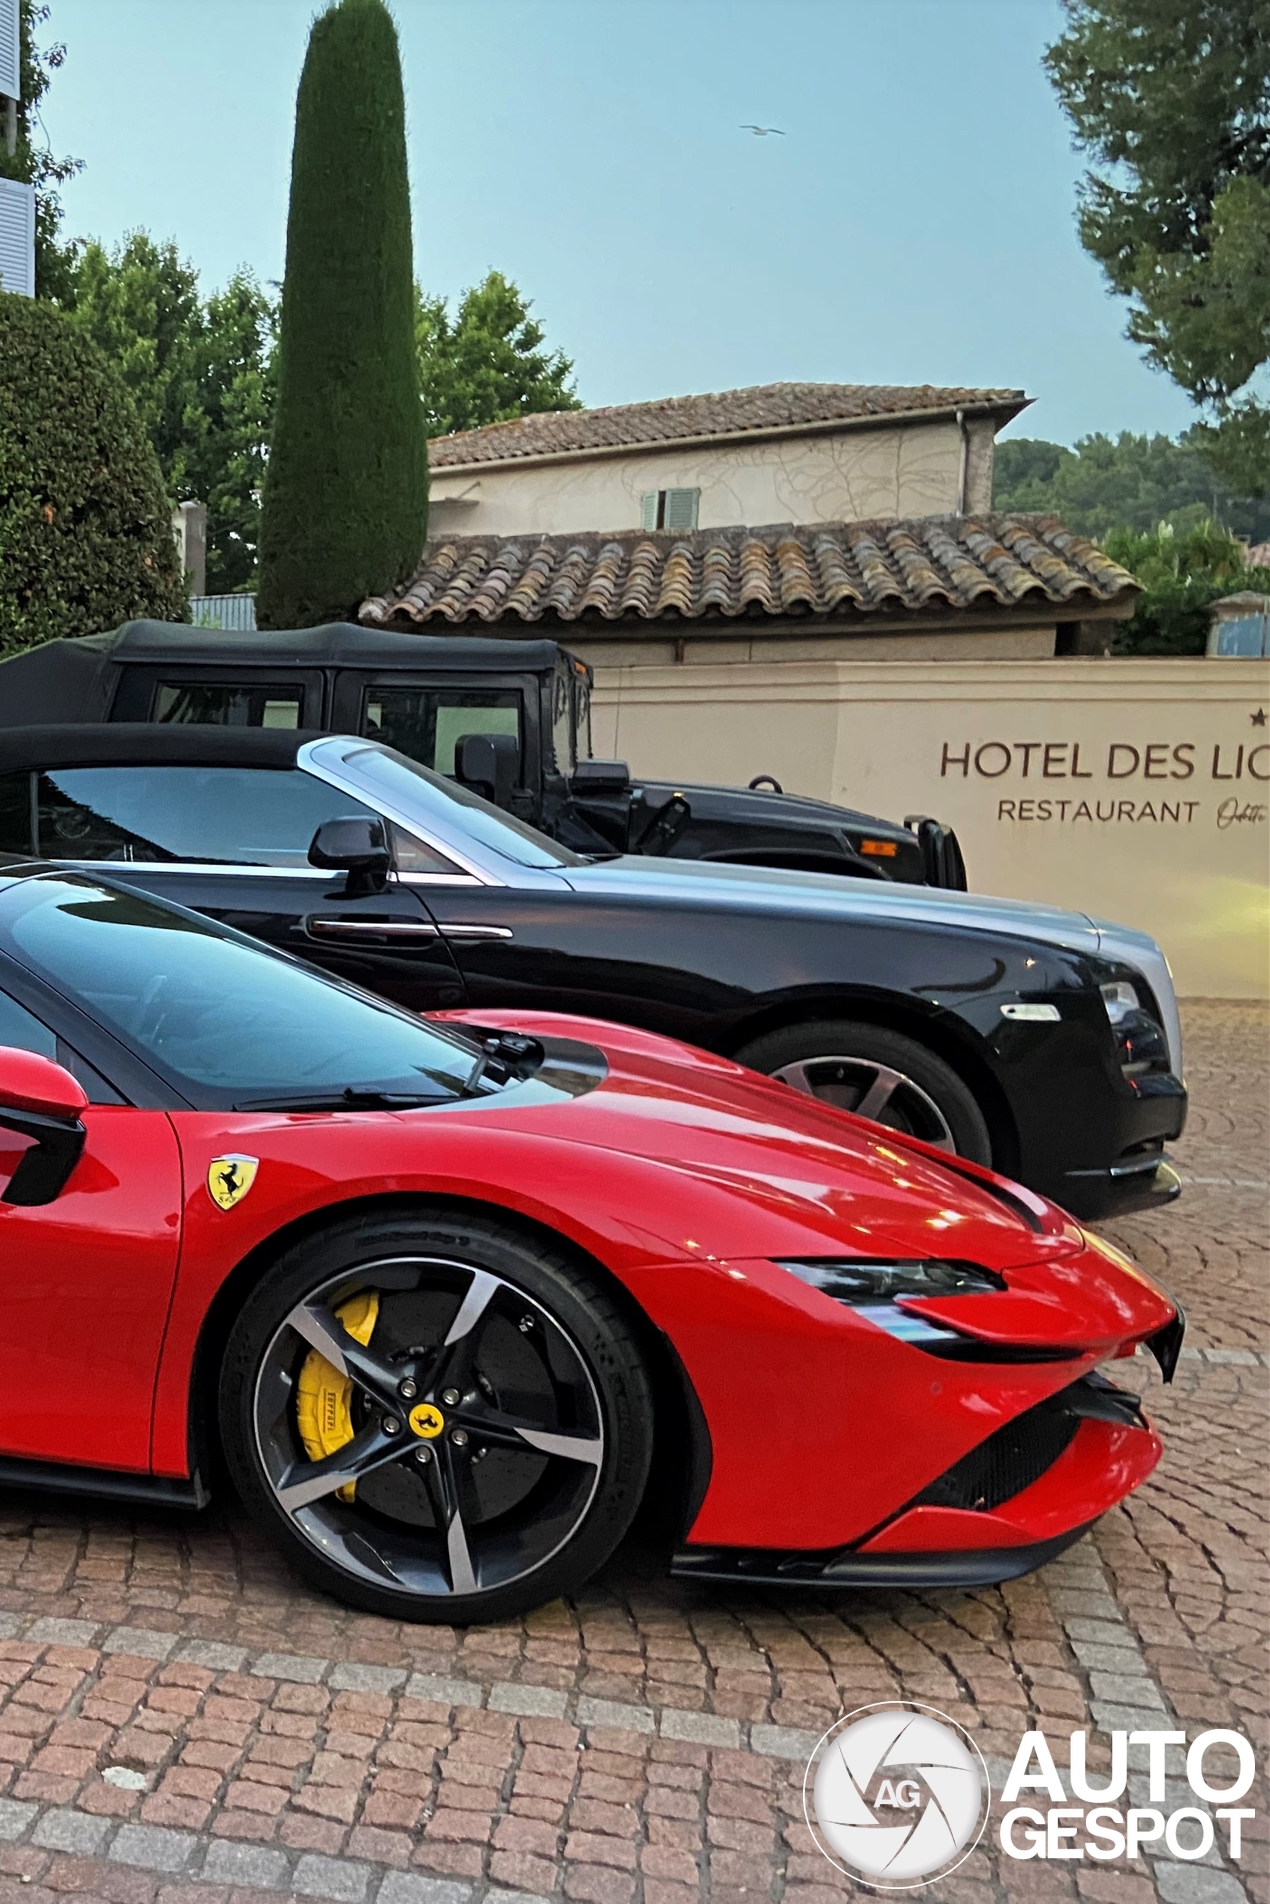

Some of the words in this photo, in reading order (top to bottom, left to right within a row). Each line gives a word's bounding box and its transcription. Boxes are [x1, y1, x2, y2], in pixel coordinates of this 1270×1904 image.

[941, 742, 1093, 778] HOTEL
[1106, 743, 1196, 779] DES
[998, 799, 1200, 823] RESTAURANT
[327, 1391, 336, 1431] Ferrari
